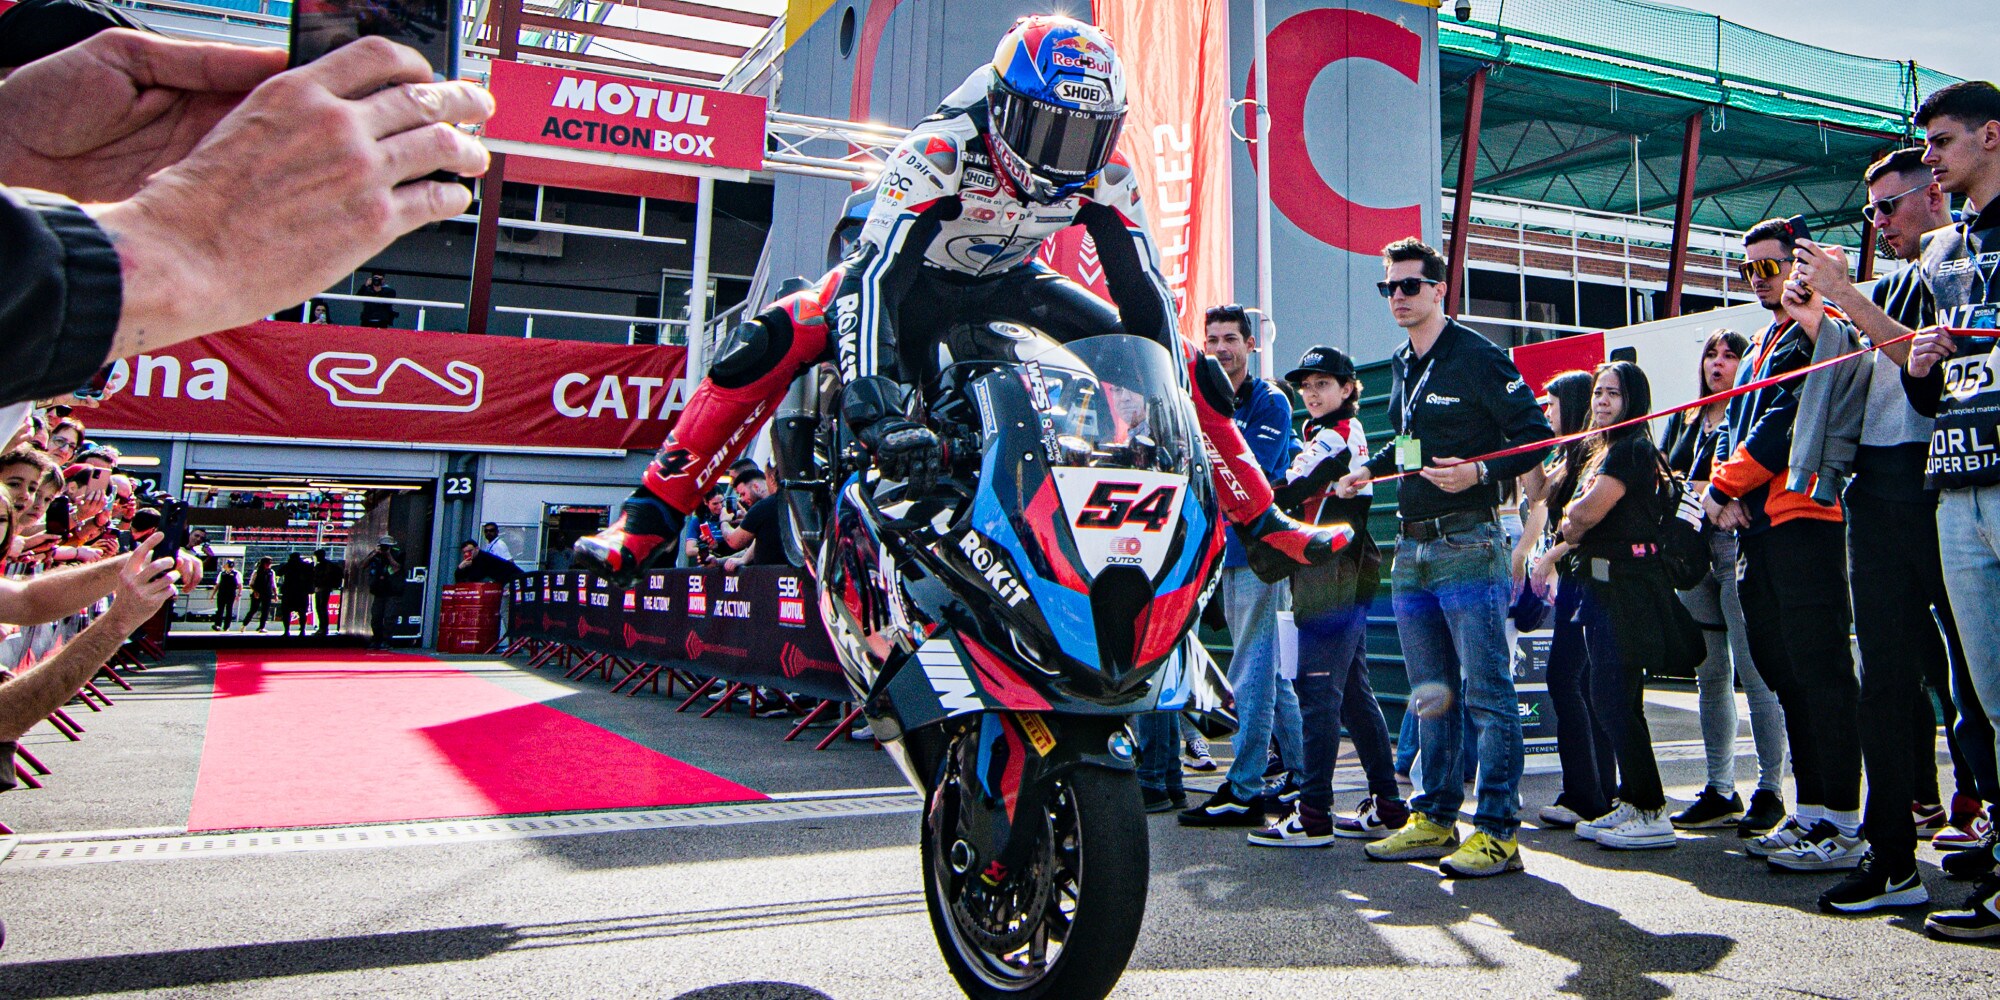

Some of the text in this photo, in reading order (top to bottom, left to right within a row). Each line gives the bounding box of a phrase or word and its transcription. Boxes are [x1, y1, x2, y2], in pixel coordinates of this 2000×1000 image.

[1053, 52, 1112, 75] Red Bull
[551, 76, 710, 127] MOTUL
[1063, 84, 1101, 102] SHOEI
[1032, 100, 1063, 115] GIVES
[1068, 109, 1091, 120] YOU
[965, 171, 995, 188] SHOEI
[1042, 164, 1087, 176] PROMETEON
[1026, 361, 1051, 411] WRS
[695, 400, 767, 490] DAINESE
[1202, 431, 1251, 502] DAINESE
[446, 477, 473, 495] 23
[1074, 480, 1179, 533] 54
[1106, 556, 1143, 564] OUTDO
[723, 600, 751, 618] ACTION!
[780, 601, 804, 620] MOTUL
[1517, 702, 1540, 716] BK
[1020, 711, 1048, 750] RELLI
